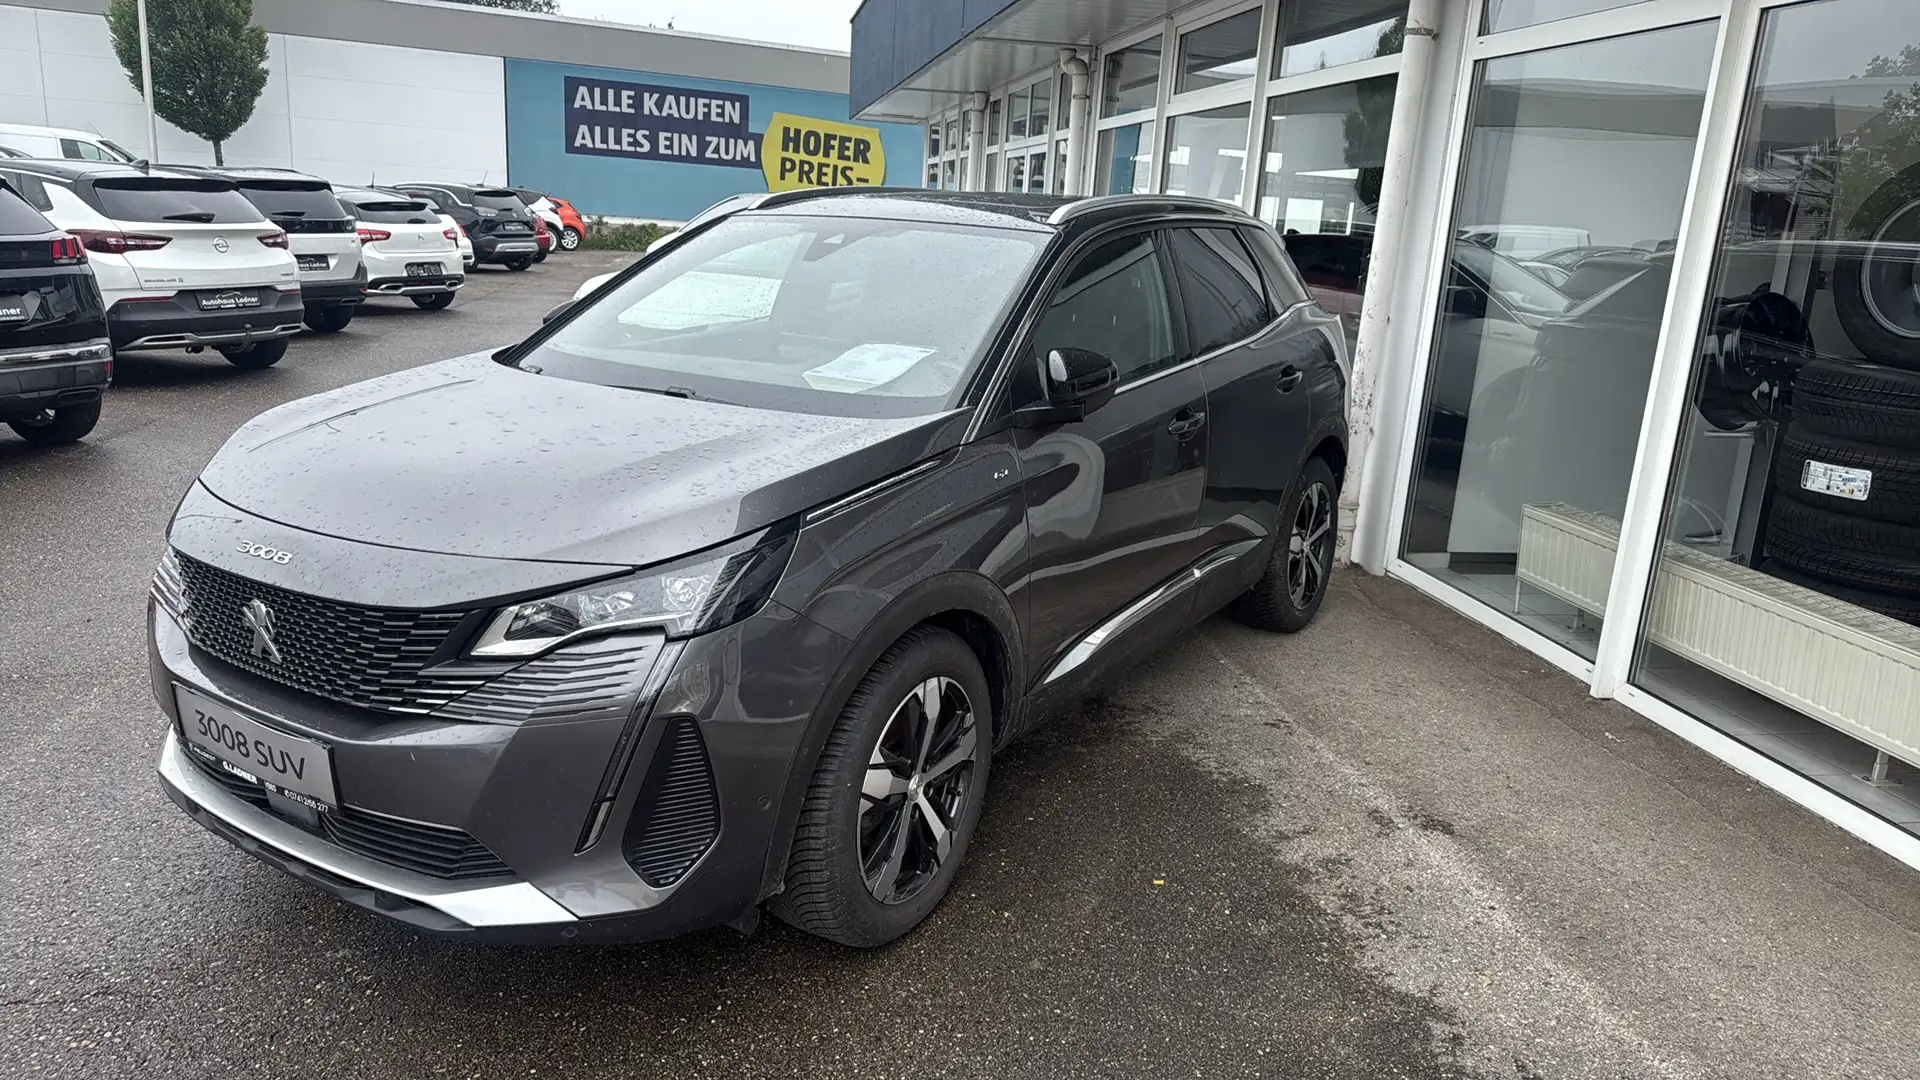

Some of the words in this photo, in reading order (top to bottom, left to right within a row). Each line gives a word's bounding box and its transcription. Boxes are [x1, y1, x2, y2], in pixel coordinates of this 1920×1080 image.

[573, 85, 636, 114] ALLE
[643, 92, 741, 124] KAUFEN
[573, 124, 650, 153] ALLES
[658, 131, 698, 157] EIN
[704, 136, 756, 162] ZUM
[781, 126, 871, 164] HOFER
[236, 539, 293, 565] 3008
[195, 709, 250, 758] 3008
[253, 740, 305, 780] SUV
